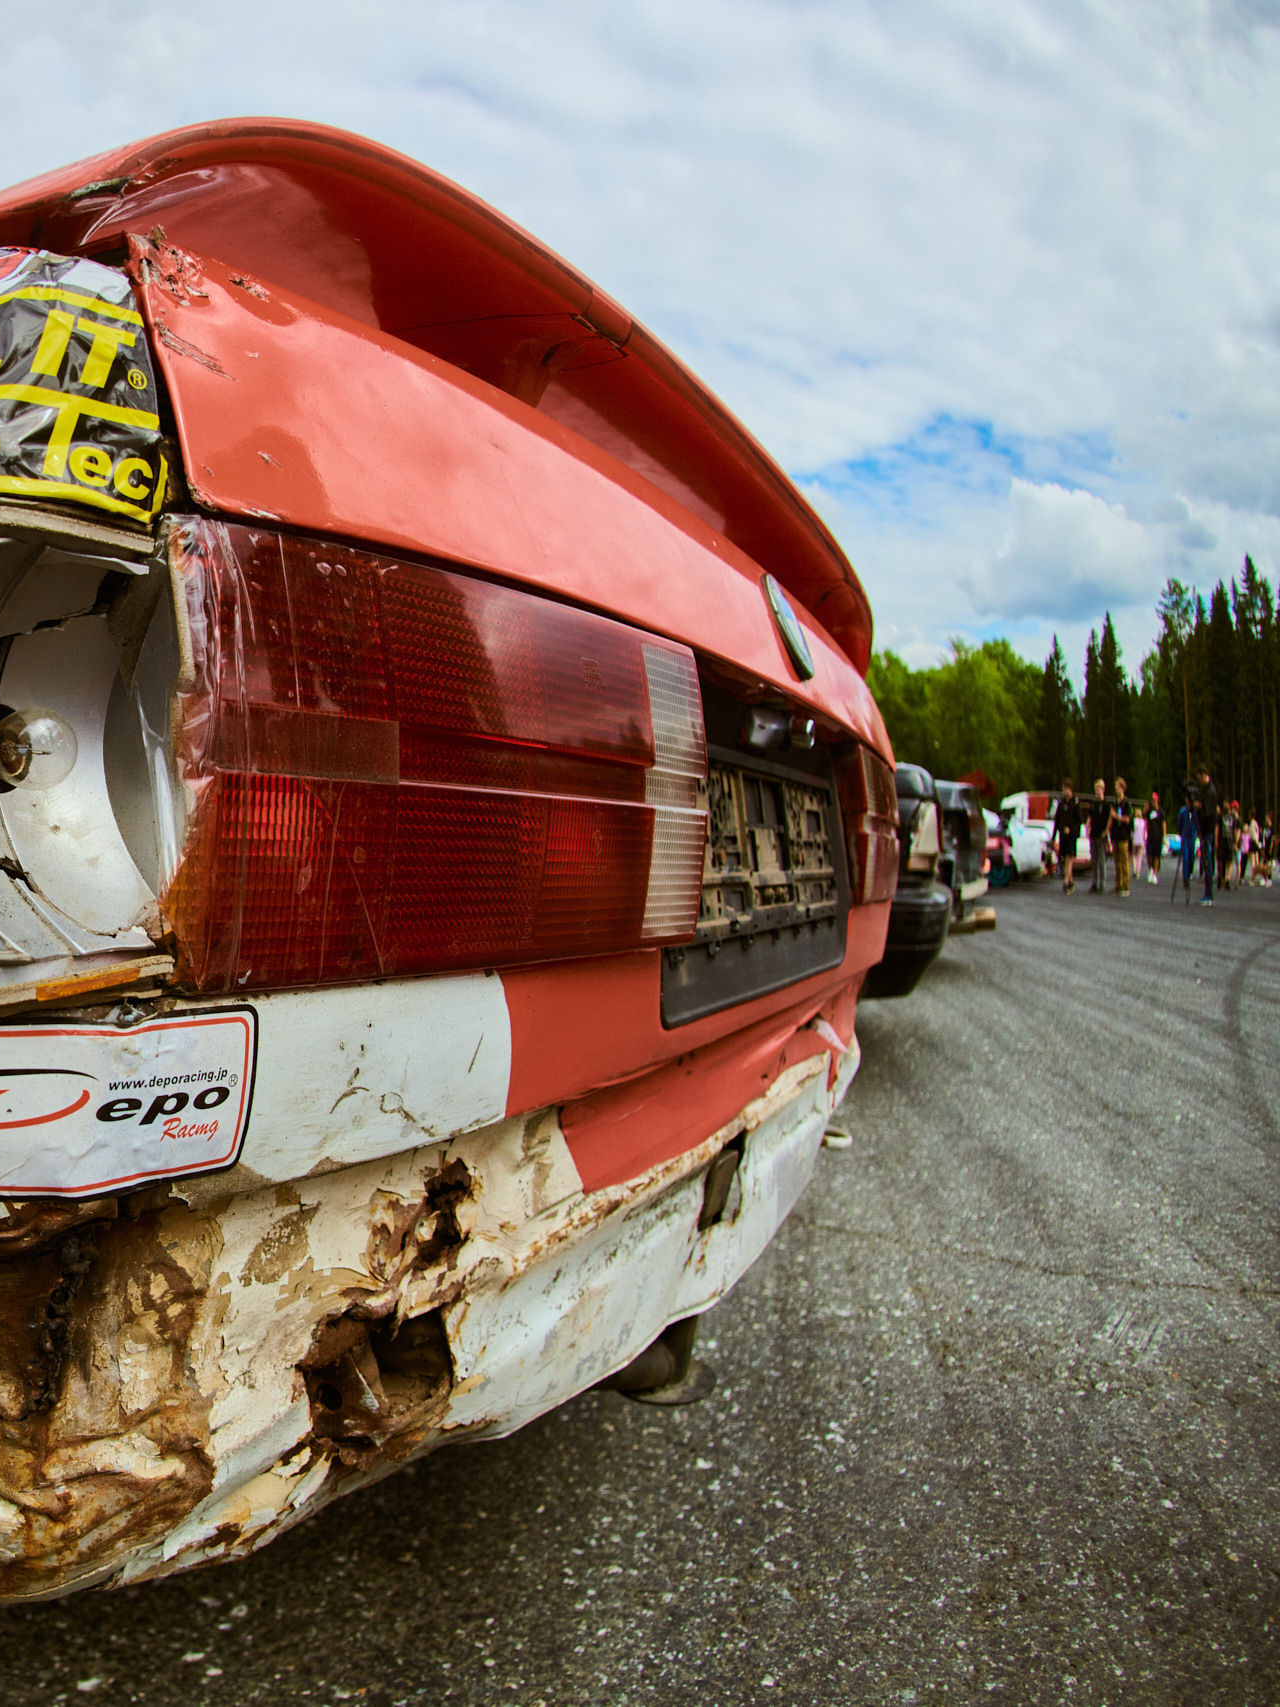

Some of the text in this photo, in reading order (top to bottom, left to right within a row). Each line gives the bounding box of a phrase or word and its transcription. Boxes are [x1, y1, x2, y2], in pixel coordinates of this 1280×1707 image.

[30, 309, 136, 388] IT
[42, 400, 154, 500] Tec
[109, 1067, 228, 1091] www.deporacing.jp
